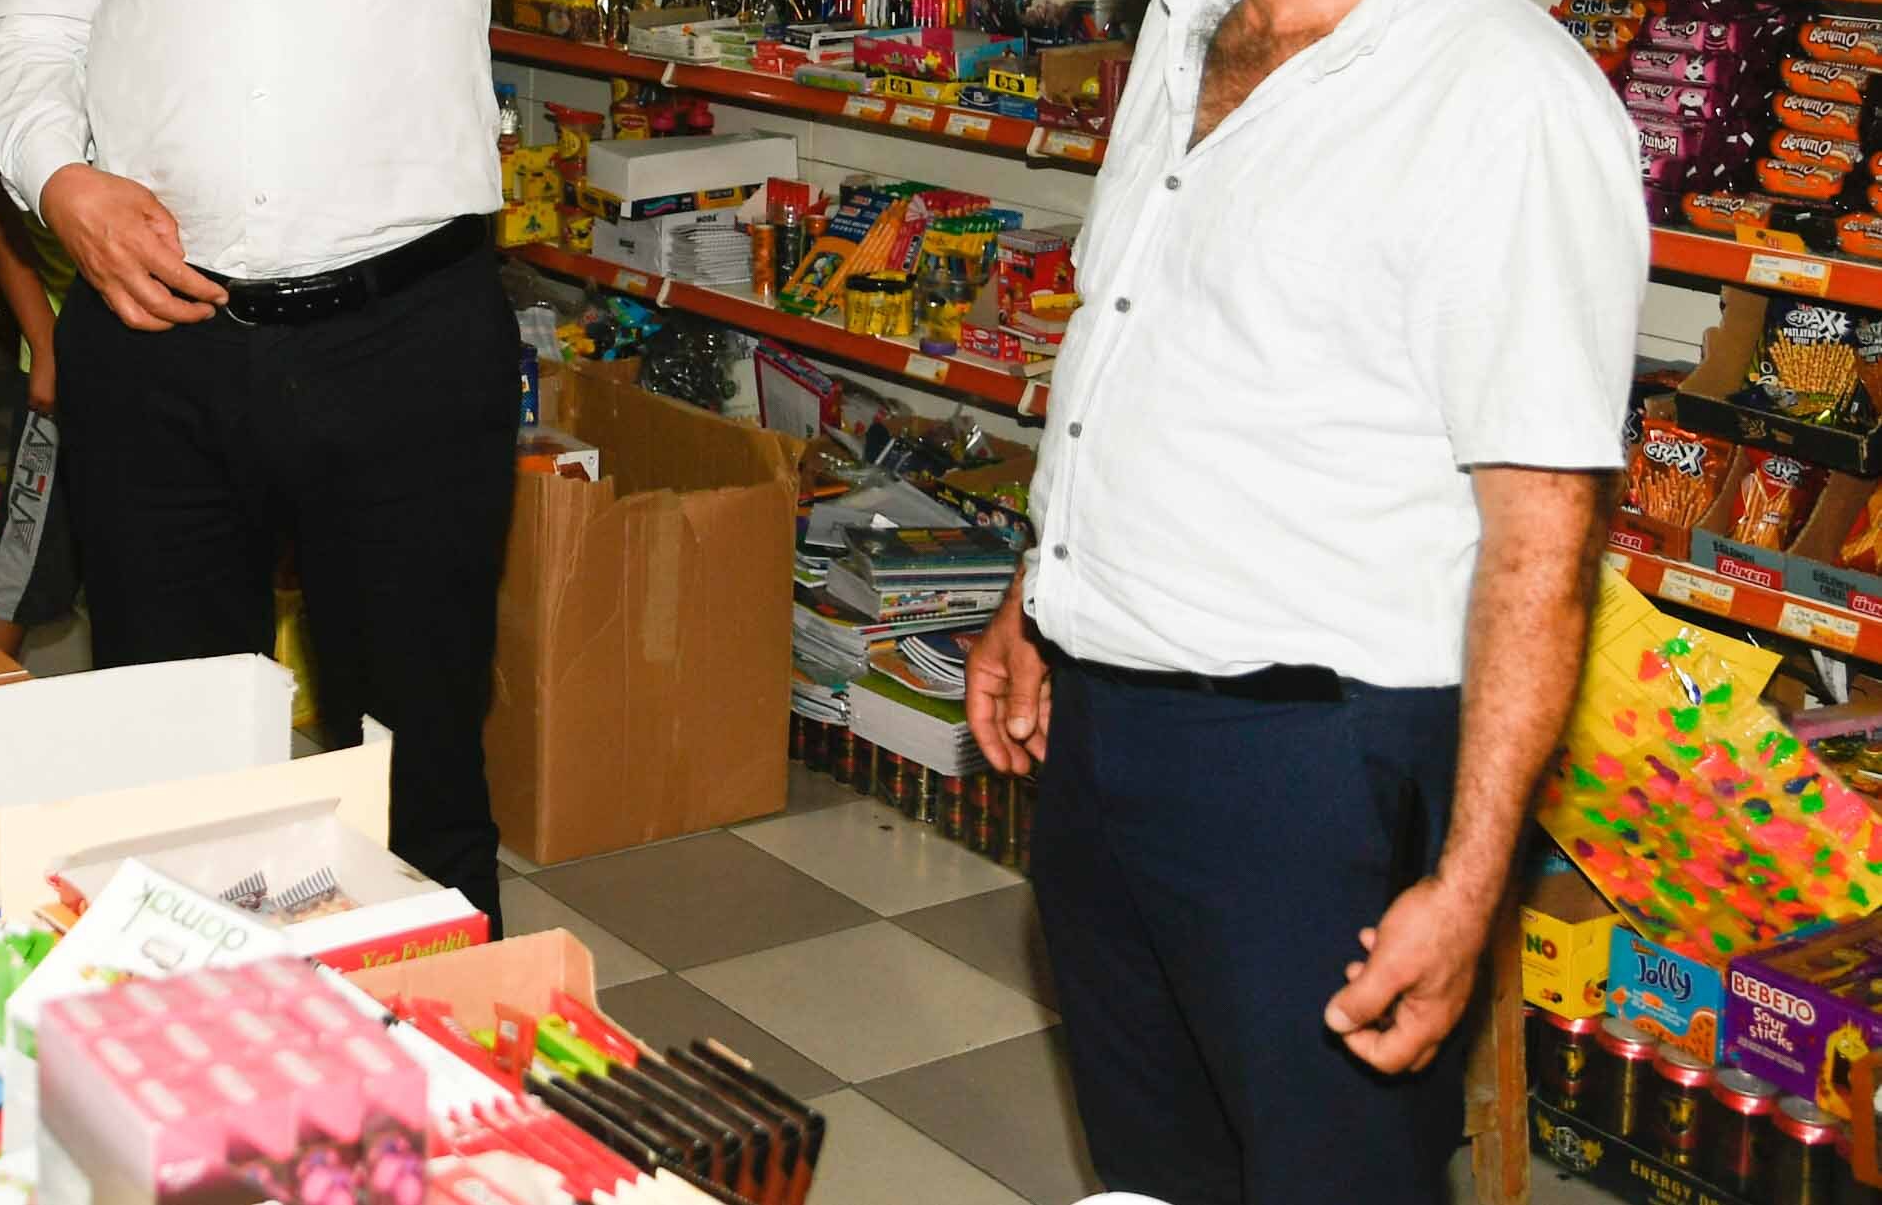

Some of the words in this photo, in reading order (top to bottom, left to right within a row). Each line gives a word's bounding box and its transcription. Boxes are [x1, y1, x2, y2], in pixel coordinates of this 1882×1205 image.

[1644, 438, 1706, 479] CRAX
[1762, 459, 1801, 482] CRA
[1612, 531, 1643, 550] KER
[1720, 560, 1772, 587] ÜLKER
[1852, 595, 1882, 616] ÜLK
[122, 879, 248, 966] damak
[1637, 954, 1694, 1003] Jolly
[1731, 970, 1816, 1025] BEBETO
[1753, 1005, 1789, 1034] Sour
[1748, 1022, 1795, 1054] sticks
[1629, 1158, 1693, 1200] ENERGY
